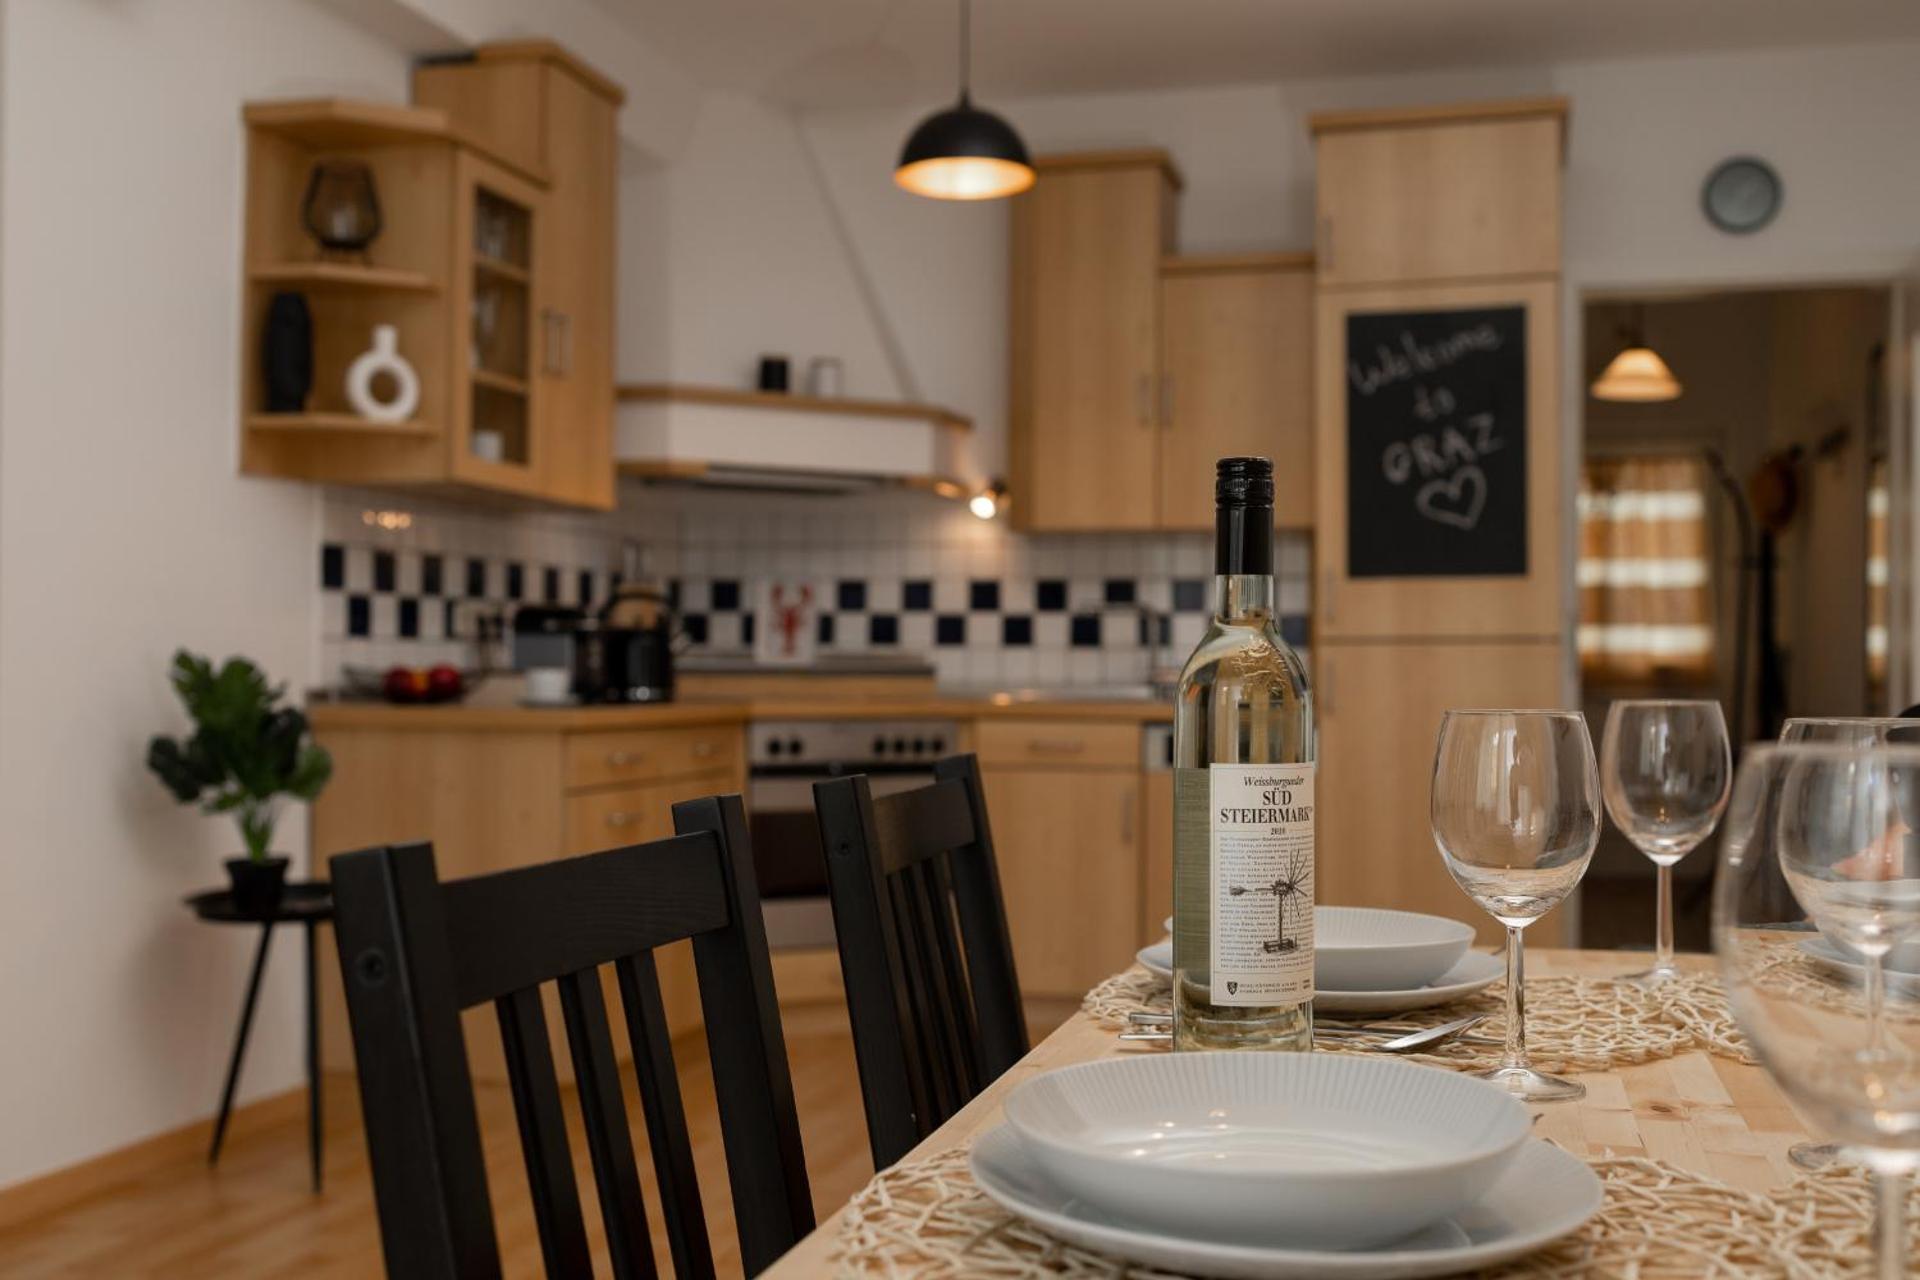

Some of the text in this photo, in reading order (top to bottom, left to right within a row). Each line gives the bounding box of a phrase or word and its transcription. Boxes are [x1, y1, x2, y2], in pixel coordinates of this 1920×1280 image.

[1382, 412, 1506, 485] GRAZ
[1262, 787, 1292, 806] SÜD
[1220, 807, 1310, 824] STEIERMARK
